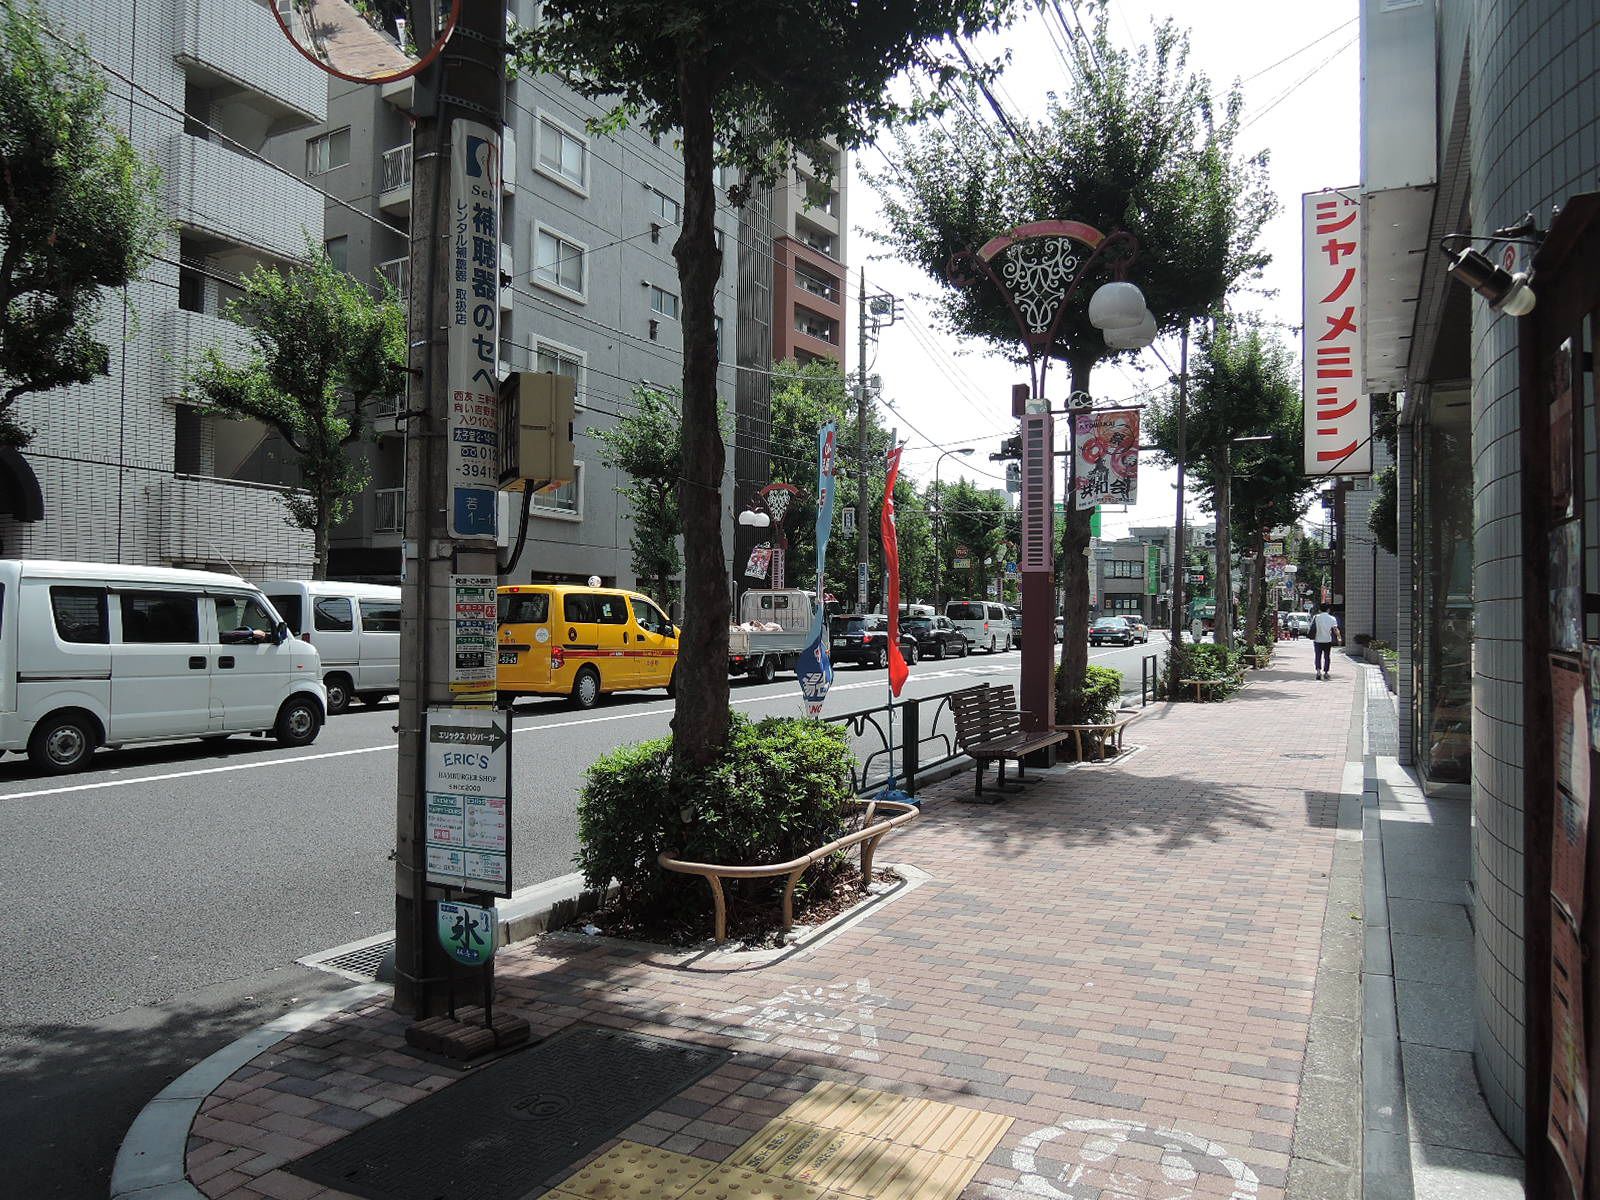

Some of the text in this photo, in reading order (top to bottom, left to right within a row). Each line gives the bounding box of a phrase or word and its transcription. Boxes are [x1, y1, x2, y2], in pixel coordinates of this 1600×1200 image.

[443, 752, 489, 769] ERIC'S
[438, 771, 497, 783] HAMBURGER SHOP
[449, 908, 485, 949] 氷
